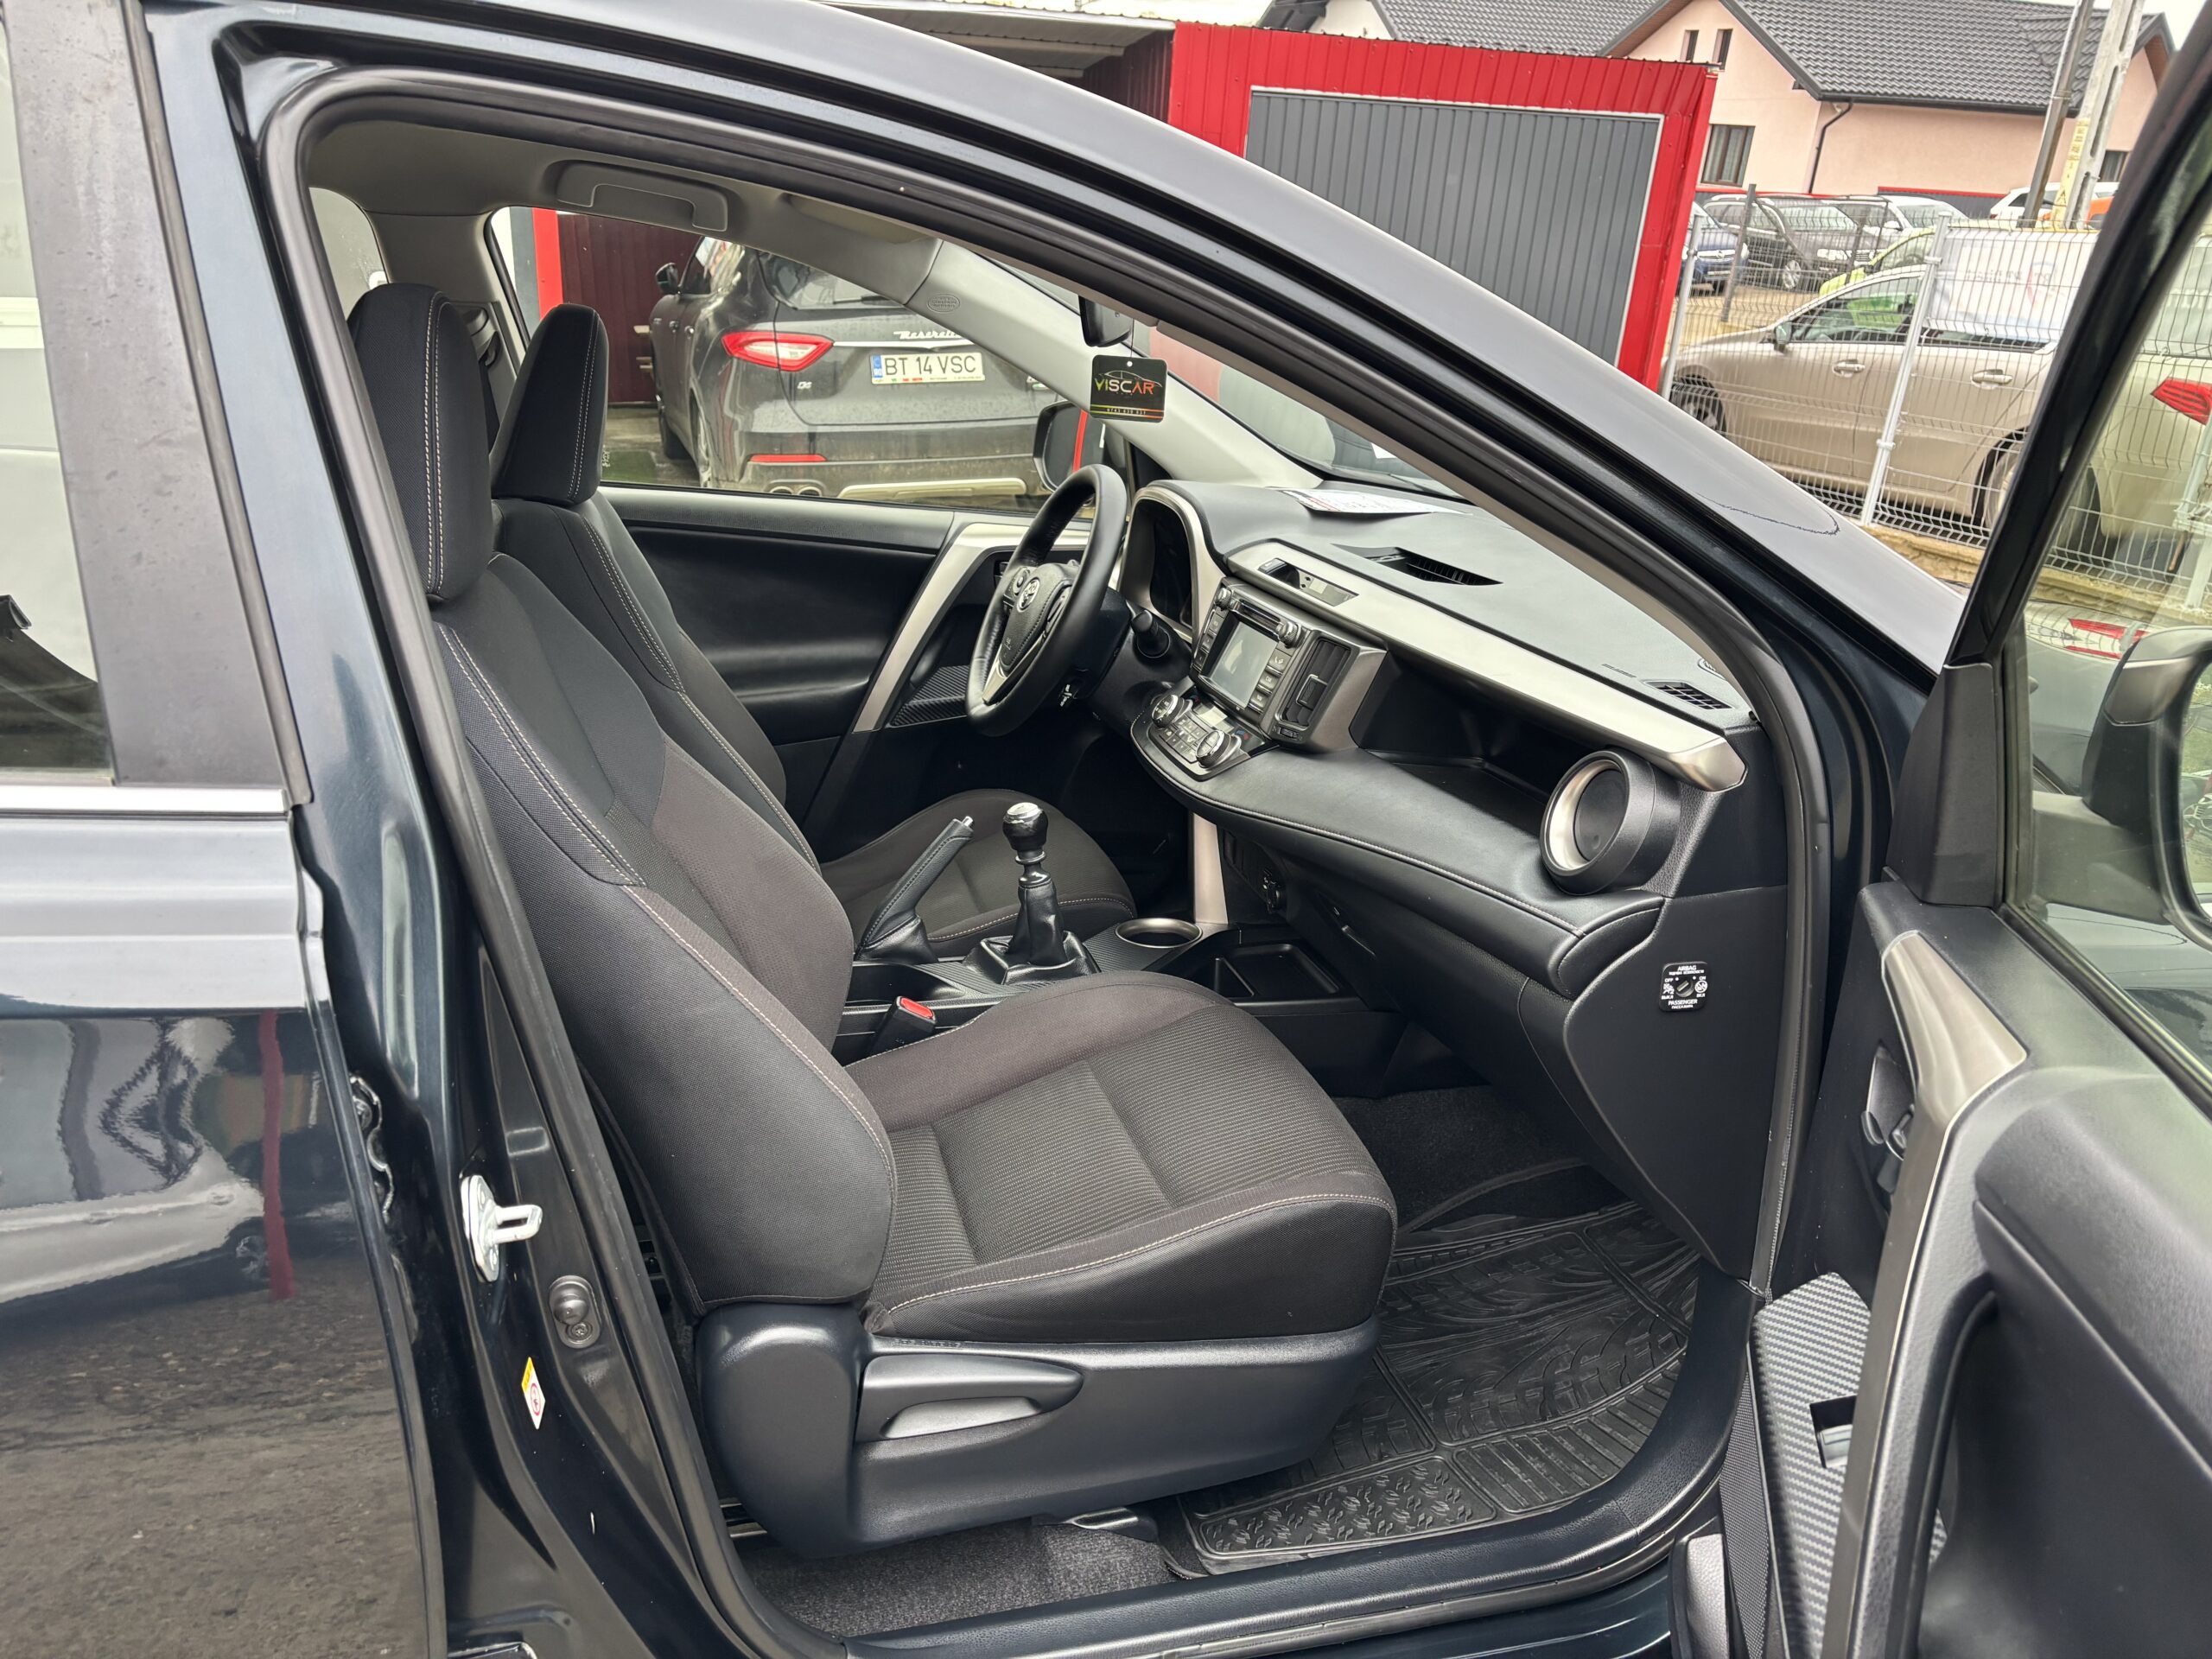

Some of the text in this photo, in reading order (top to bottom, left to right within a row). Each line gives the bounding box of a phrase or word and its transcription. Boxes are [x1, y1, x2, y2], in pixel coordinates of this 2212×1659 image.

[884, 355, 976, 375] BT 14 VSC
[1094, 378, 1155, 395] VISCAR
